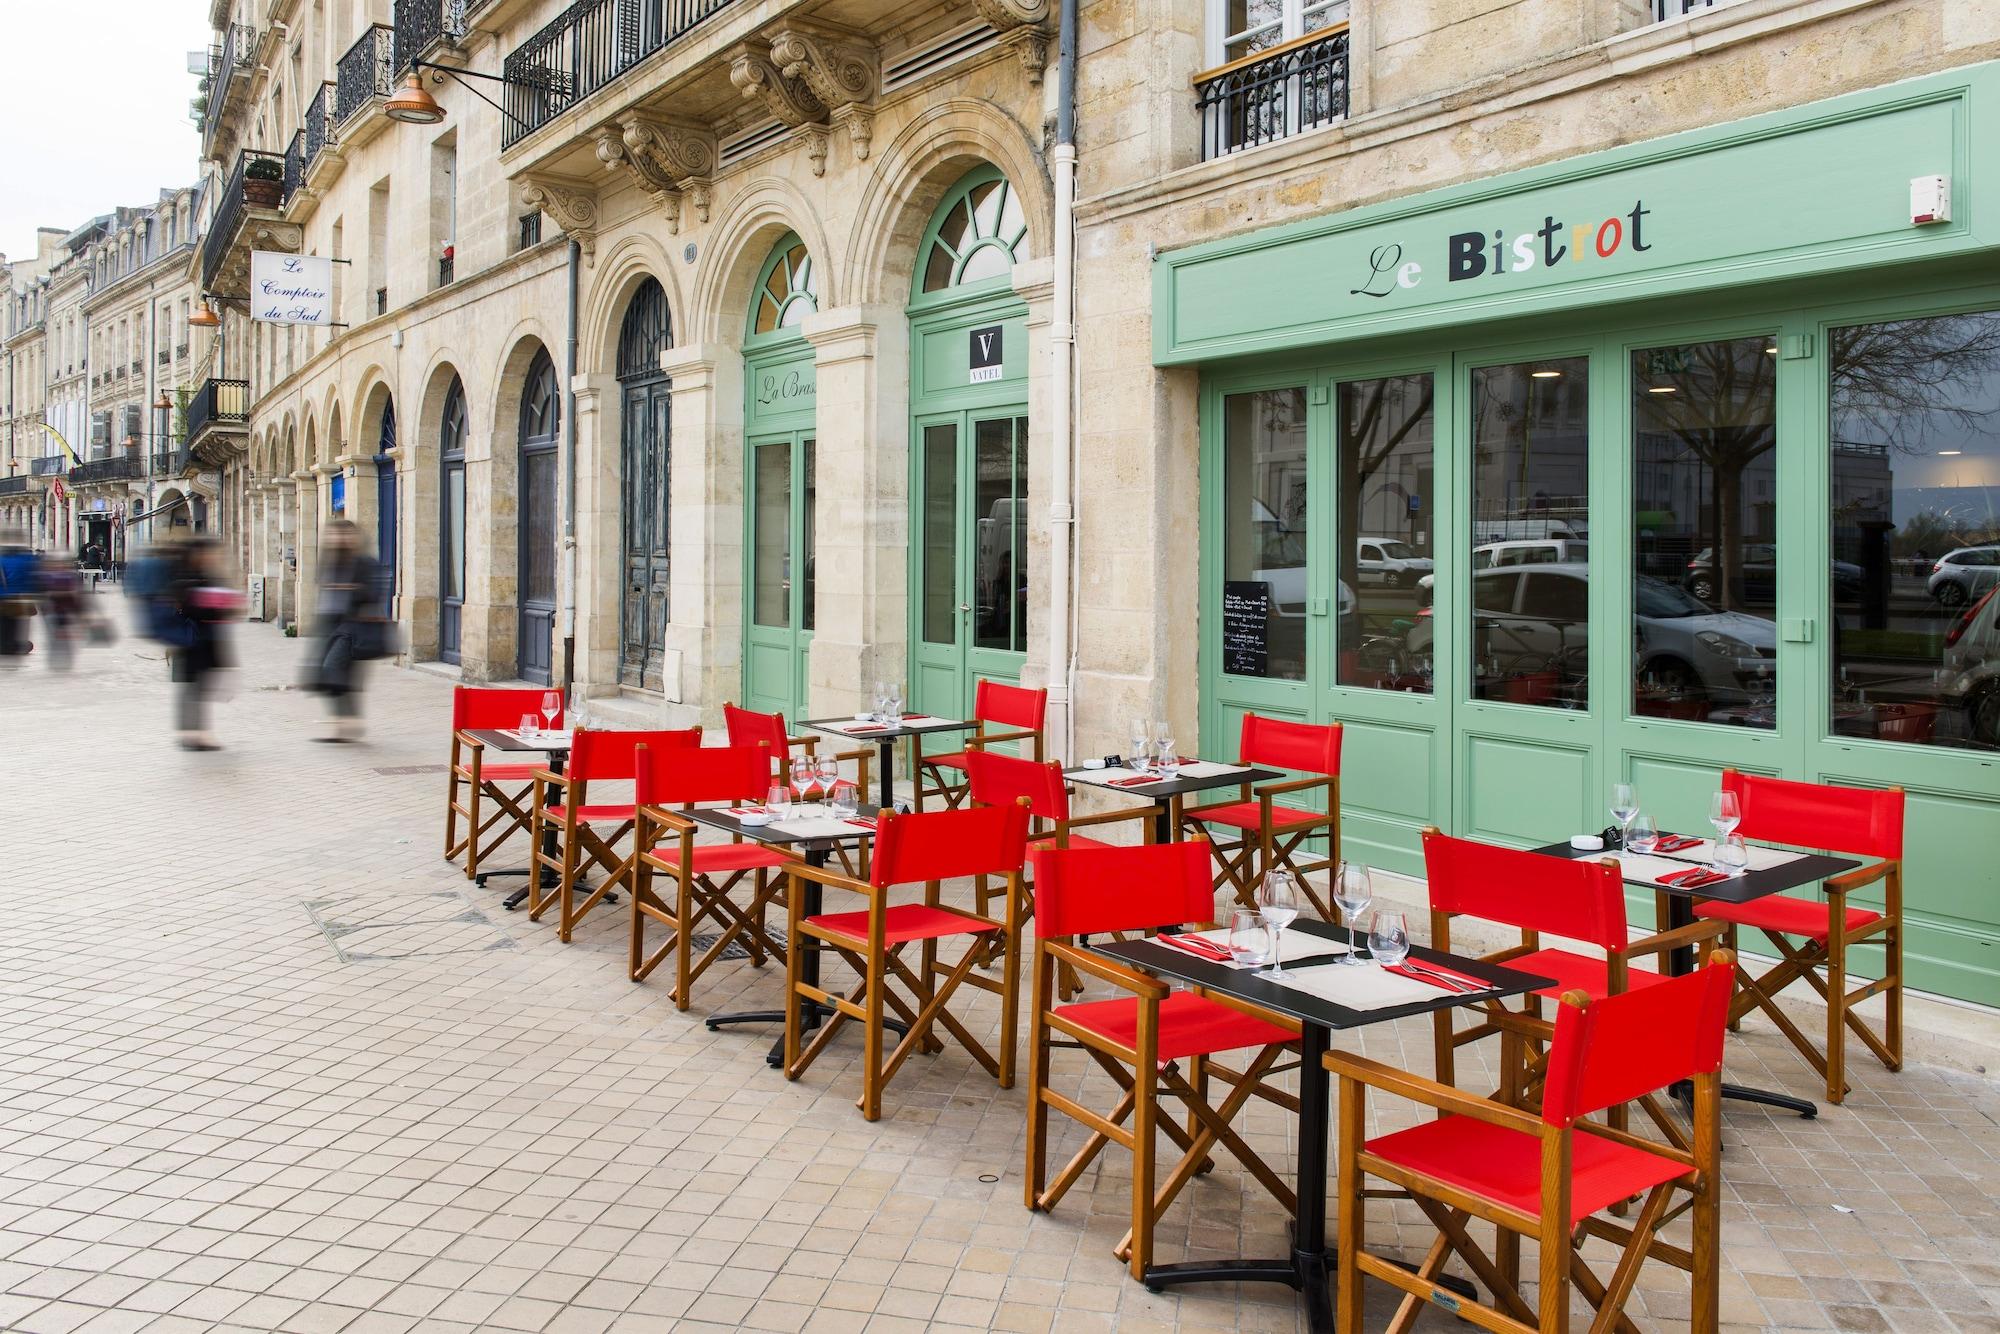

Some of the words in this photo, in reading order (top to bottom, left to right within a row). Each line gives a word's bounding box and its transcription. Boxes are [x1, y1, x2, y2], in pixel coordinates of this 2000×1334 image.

[1350, 240, 1422, 297] Le
[1448, 200, 1652, 282] Bistrot
[282, 258, 304, 273] Le
[260, 279, 327, 300] Comptoir
[264, 306, 282, 319] du
[287, 305, 322, 321] Sud
[977, 332, 995, 362] V
[972, 368, 1001, 381] VATEL
[757, 375, 779, 405] La
